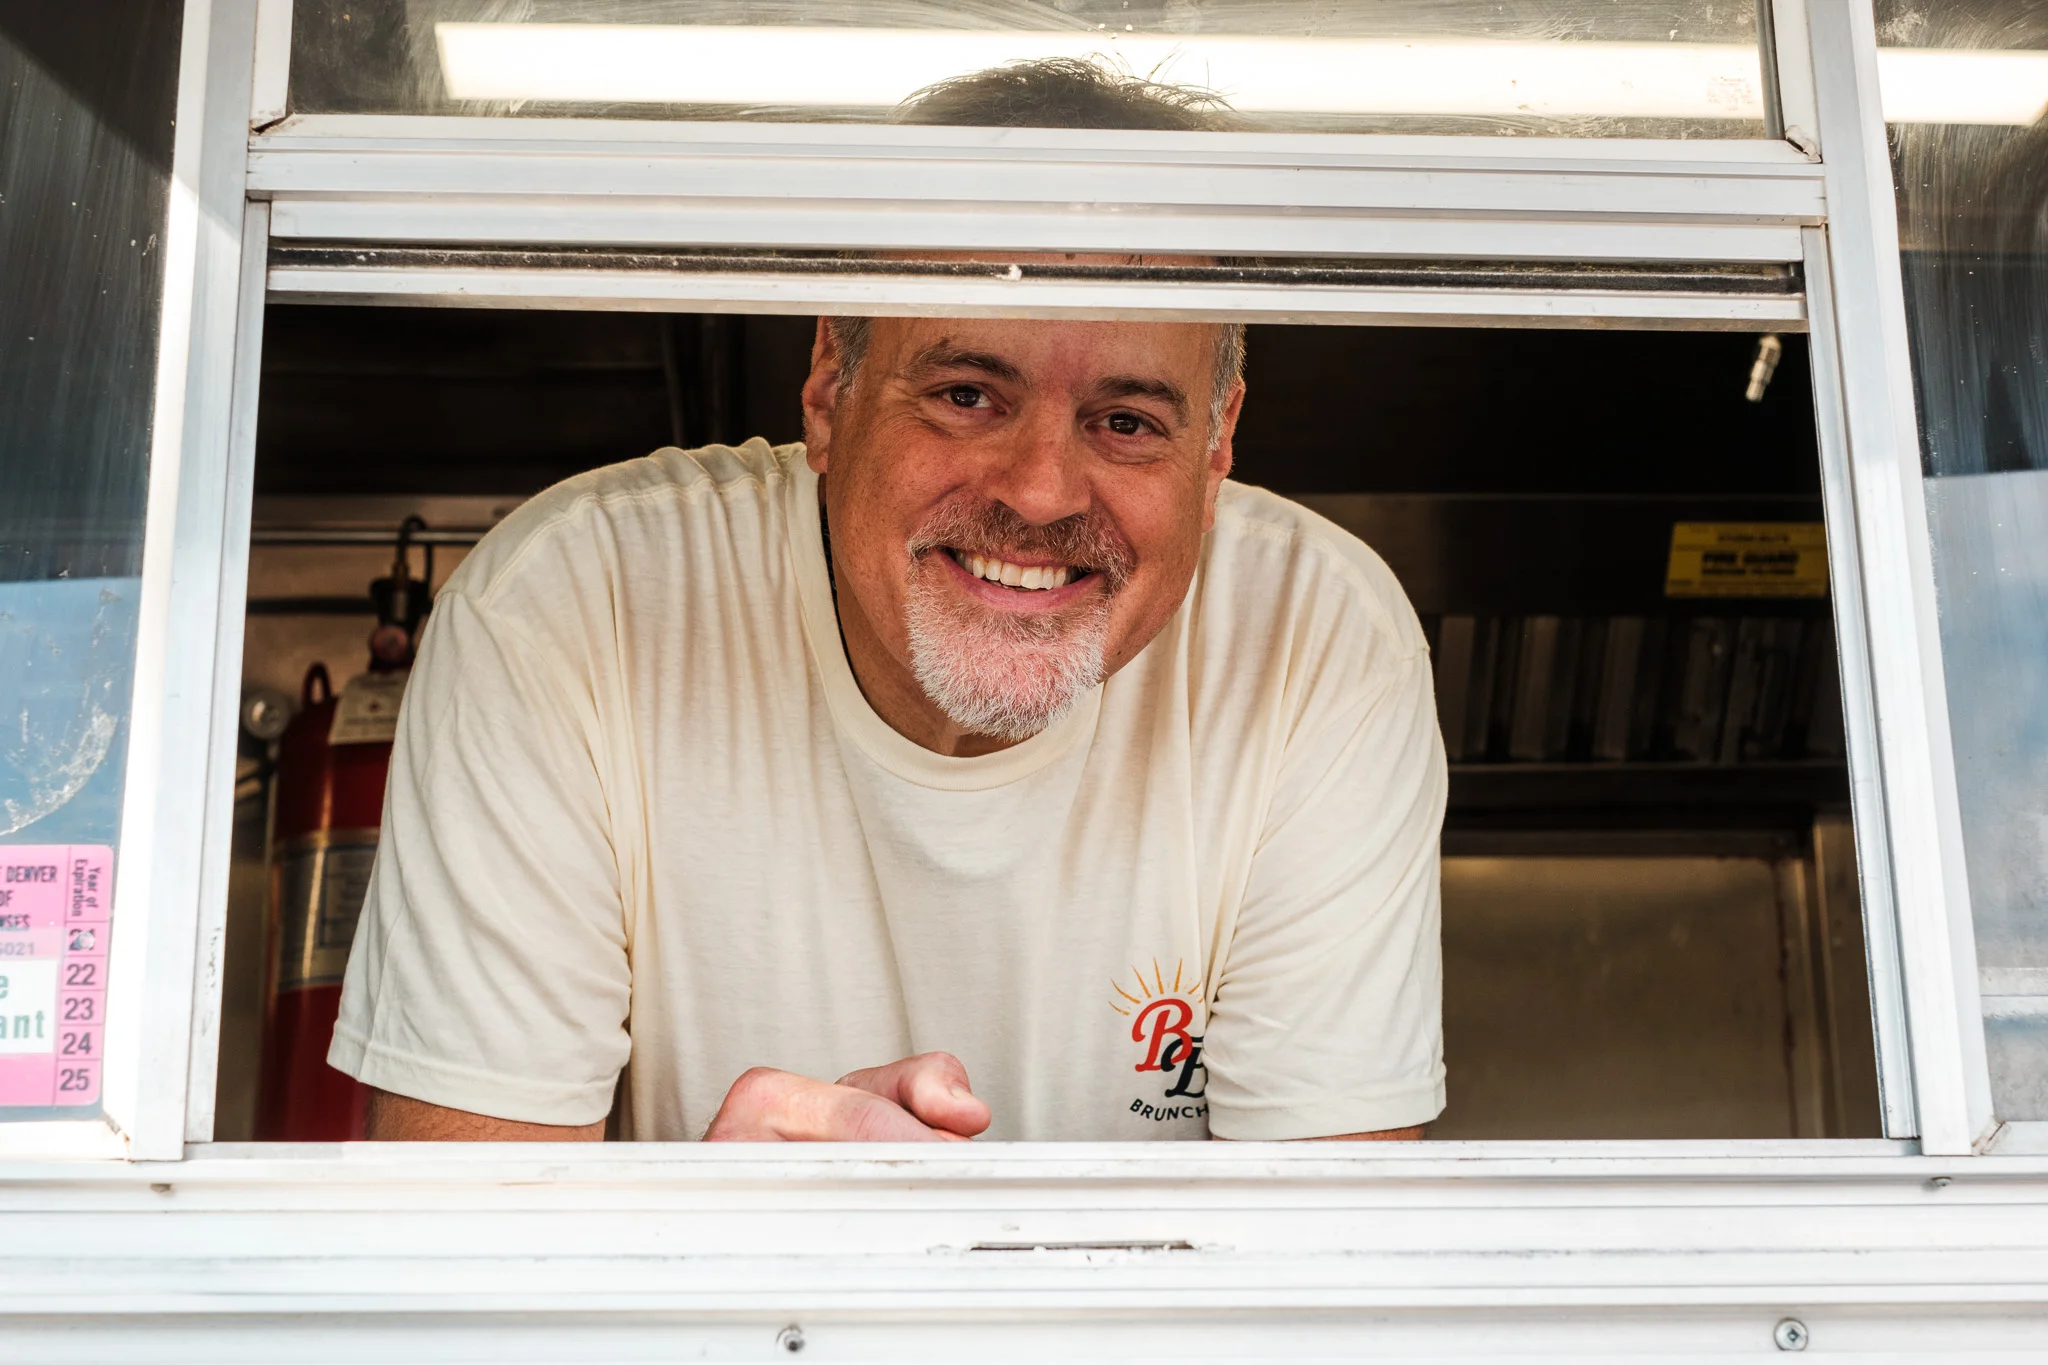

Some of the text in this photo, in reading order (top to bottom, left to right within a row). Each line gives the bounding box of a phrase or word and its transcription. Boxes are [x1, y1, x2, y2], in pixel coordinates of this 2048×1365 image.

[6, 865, 58, 882] DENVER
[72, 859, 88, 917] Expiration
[86, 867, 101, 908] Year of
[69, 927, 95, 950] 2
[65, 963, 96, 986] 22
[64, 997, 94, 1020] 23
[62, 1032, 92, 1055] 24
[60, 1068, 90, 1091] 25
[1129, 1098, 1209, 1122] BRUNCH
